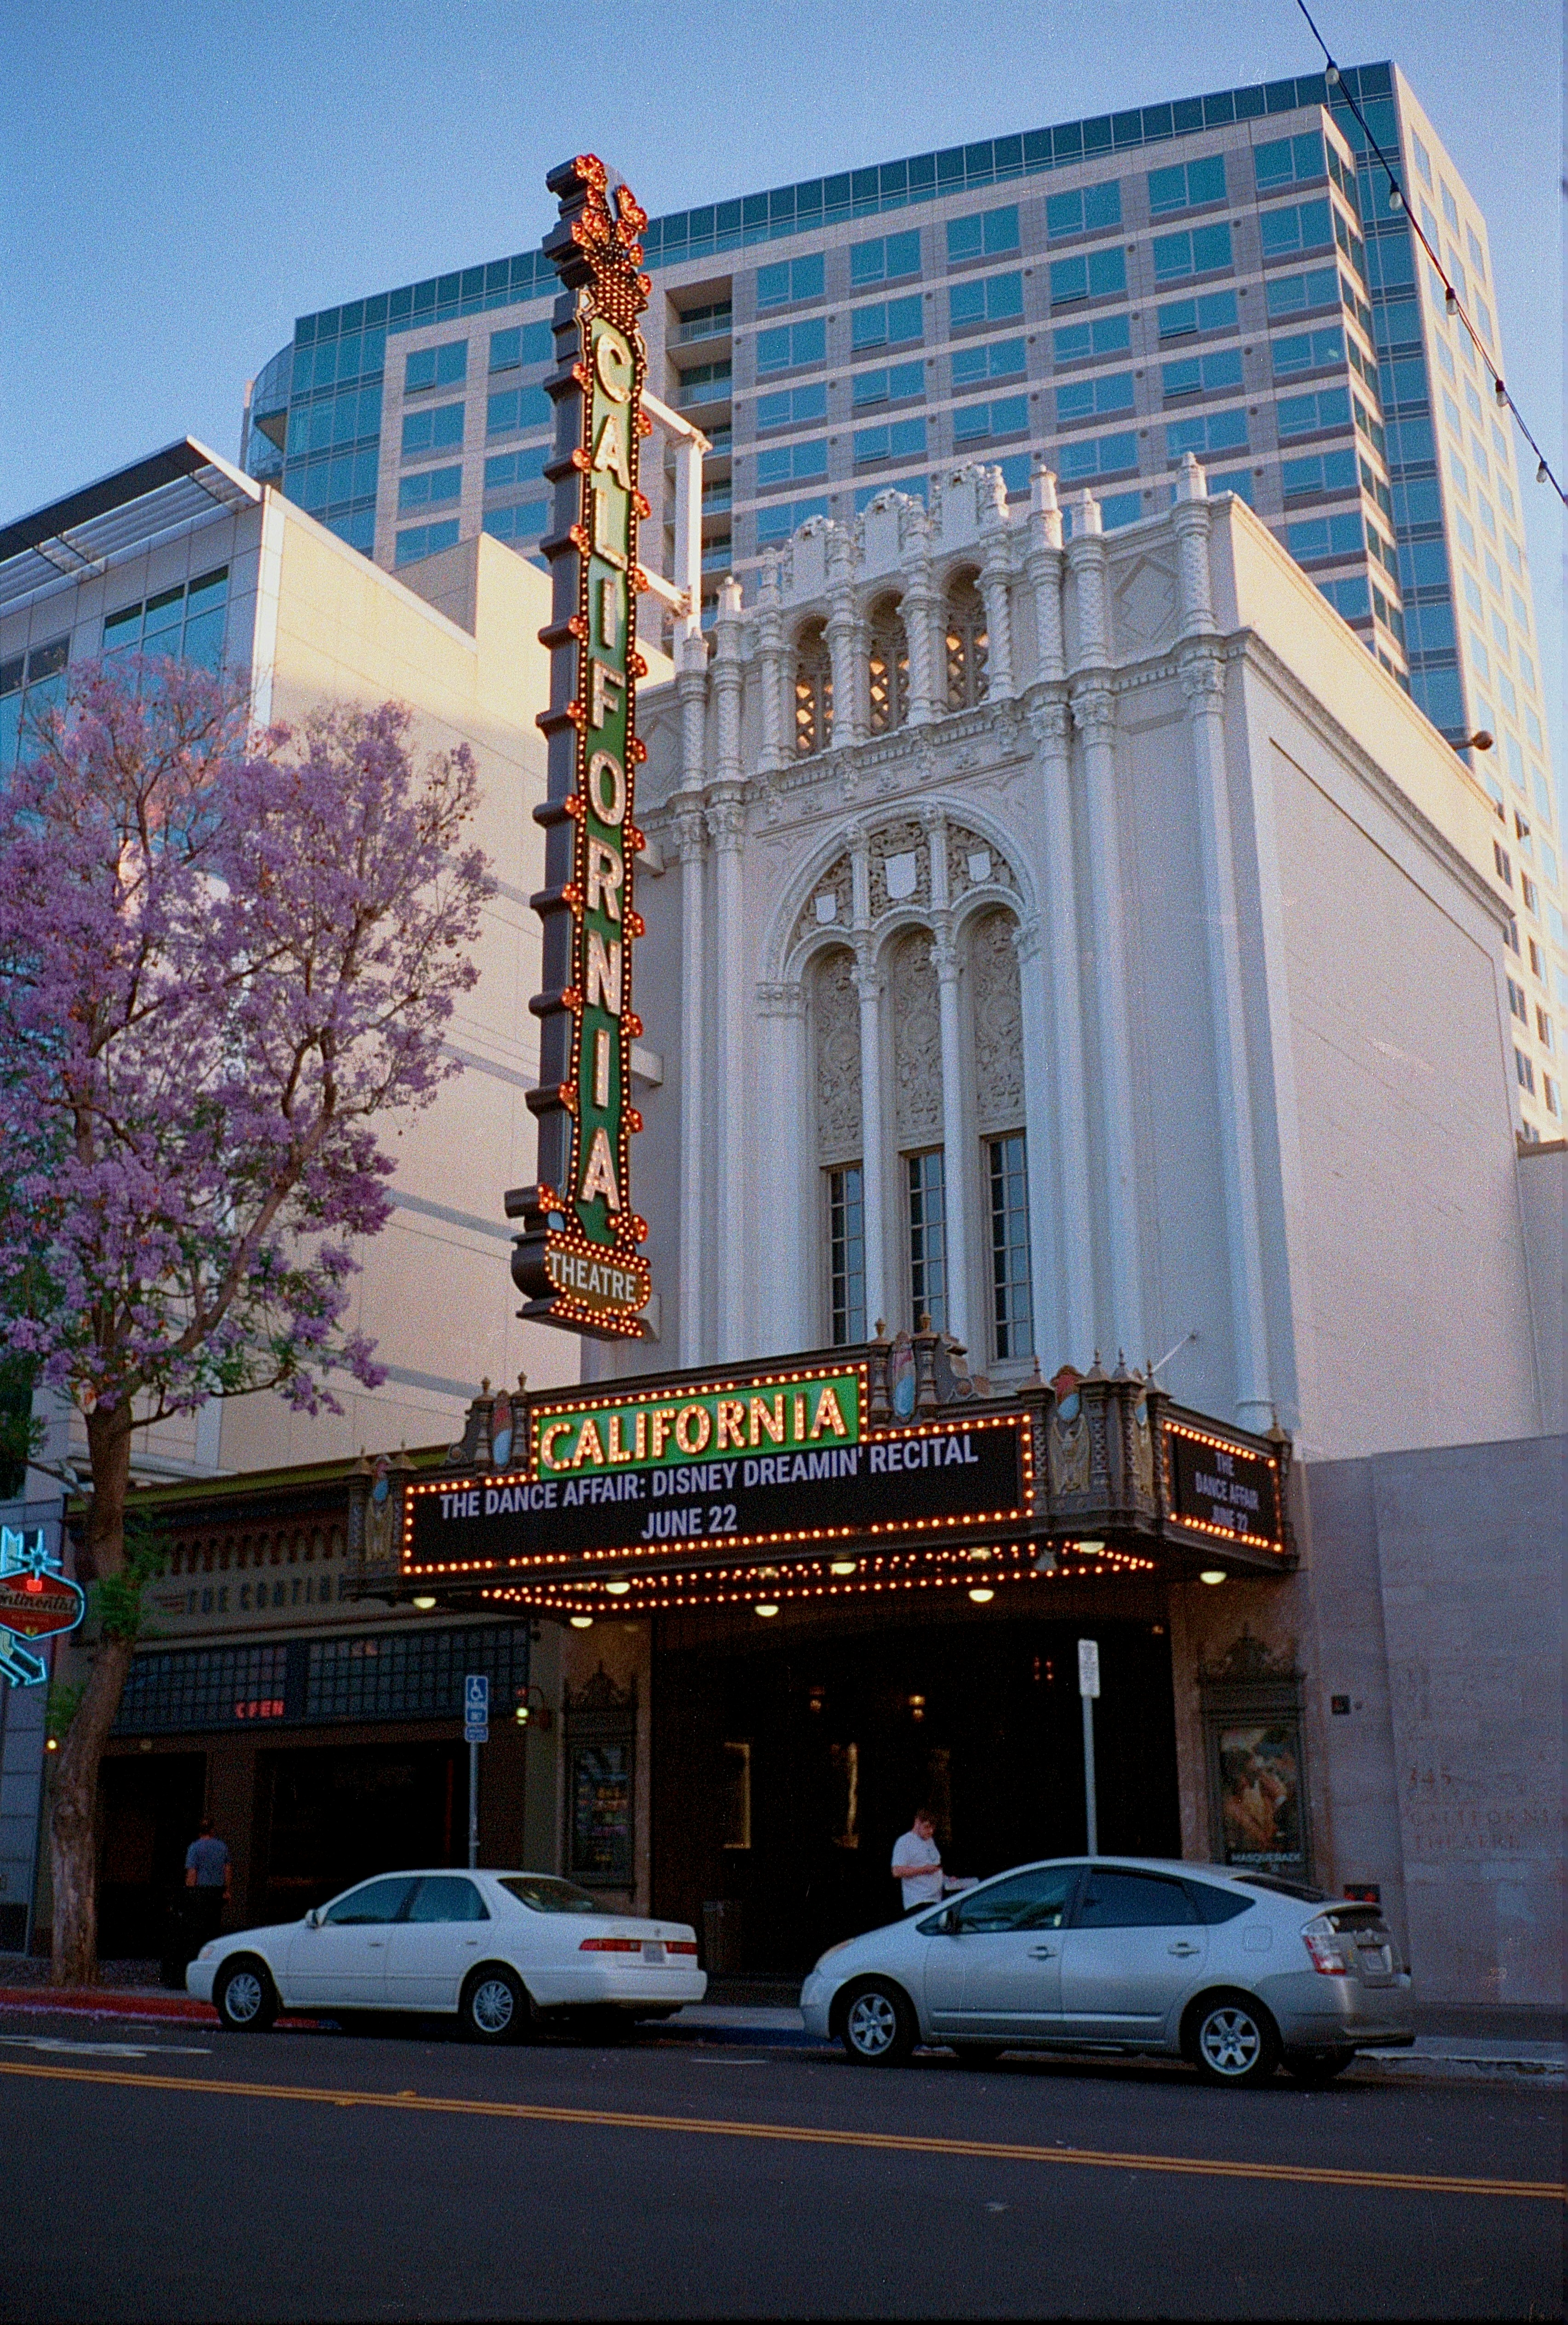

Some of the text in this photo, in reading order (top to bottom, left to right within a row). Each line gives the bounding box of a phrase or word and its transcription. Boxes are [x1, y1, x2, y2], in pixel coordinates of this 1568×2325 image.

[580, 333, 633, 1211] CALIFORNIA
[548, 1251, 637, 1303] THEATRE
[540, 1387, 847, 1471] CALIFORNIA
[440, 1435, 979, 1519] THE DANCE AFFAIR: DISNEY DREAMIN' RECITAL
[1215, 1451, 1235, 1476] THE
[1196, 1471, 1229, 1502] DANCE
[642, 1504, 737, 1539] JUNE 22
[235, 1699, 285, 1719] OPEN
